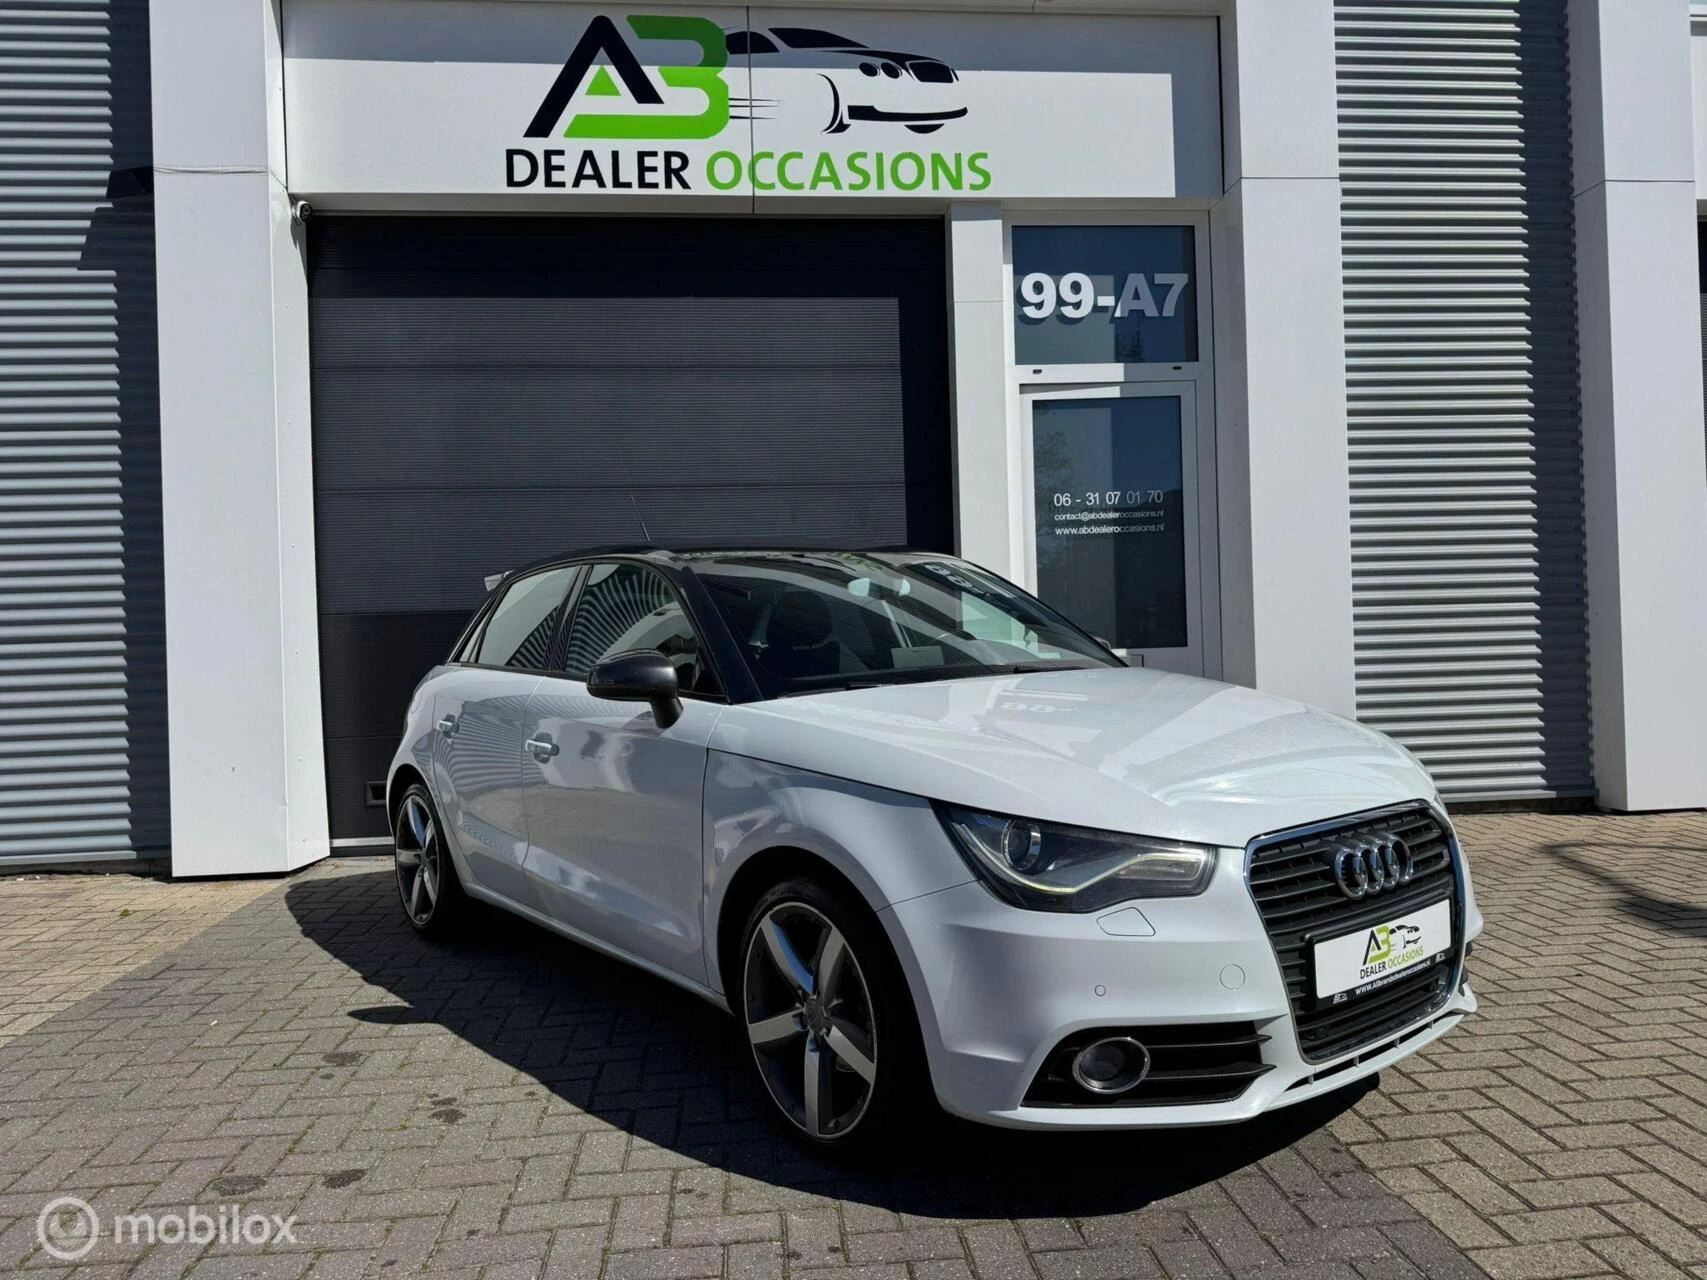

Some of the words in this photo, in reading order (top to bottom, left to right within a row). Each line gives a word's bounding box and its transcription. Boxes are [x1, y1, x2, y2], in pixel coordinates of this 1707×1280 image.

[523, 14, 729, 139] AB
[505, 148, 691, 190] DEALER
[706, 150, 992, 192] OCCASIONS
[1020, 272, 1189, 319] 99-A7
[1053, 492, 1072, 507] 06
[1085, 492, 1100, 505] 31
[1105, 491, 1121, 504] 07
[1126, 490, 1141, 503] 01
[1147, 489, 1163, 503] 70
[1054, 511, 1164, 521] contact@abdealeroccasions.nl
[1054, 523, 1165, 535] www.abdealeroccasions.nl
[1360, 962, 1387, 979] DEALER
[1387, 946, 1424, 968] OCCASIONS
